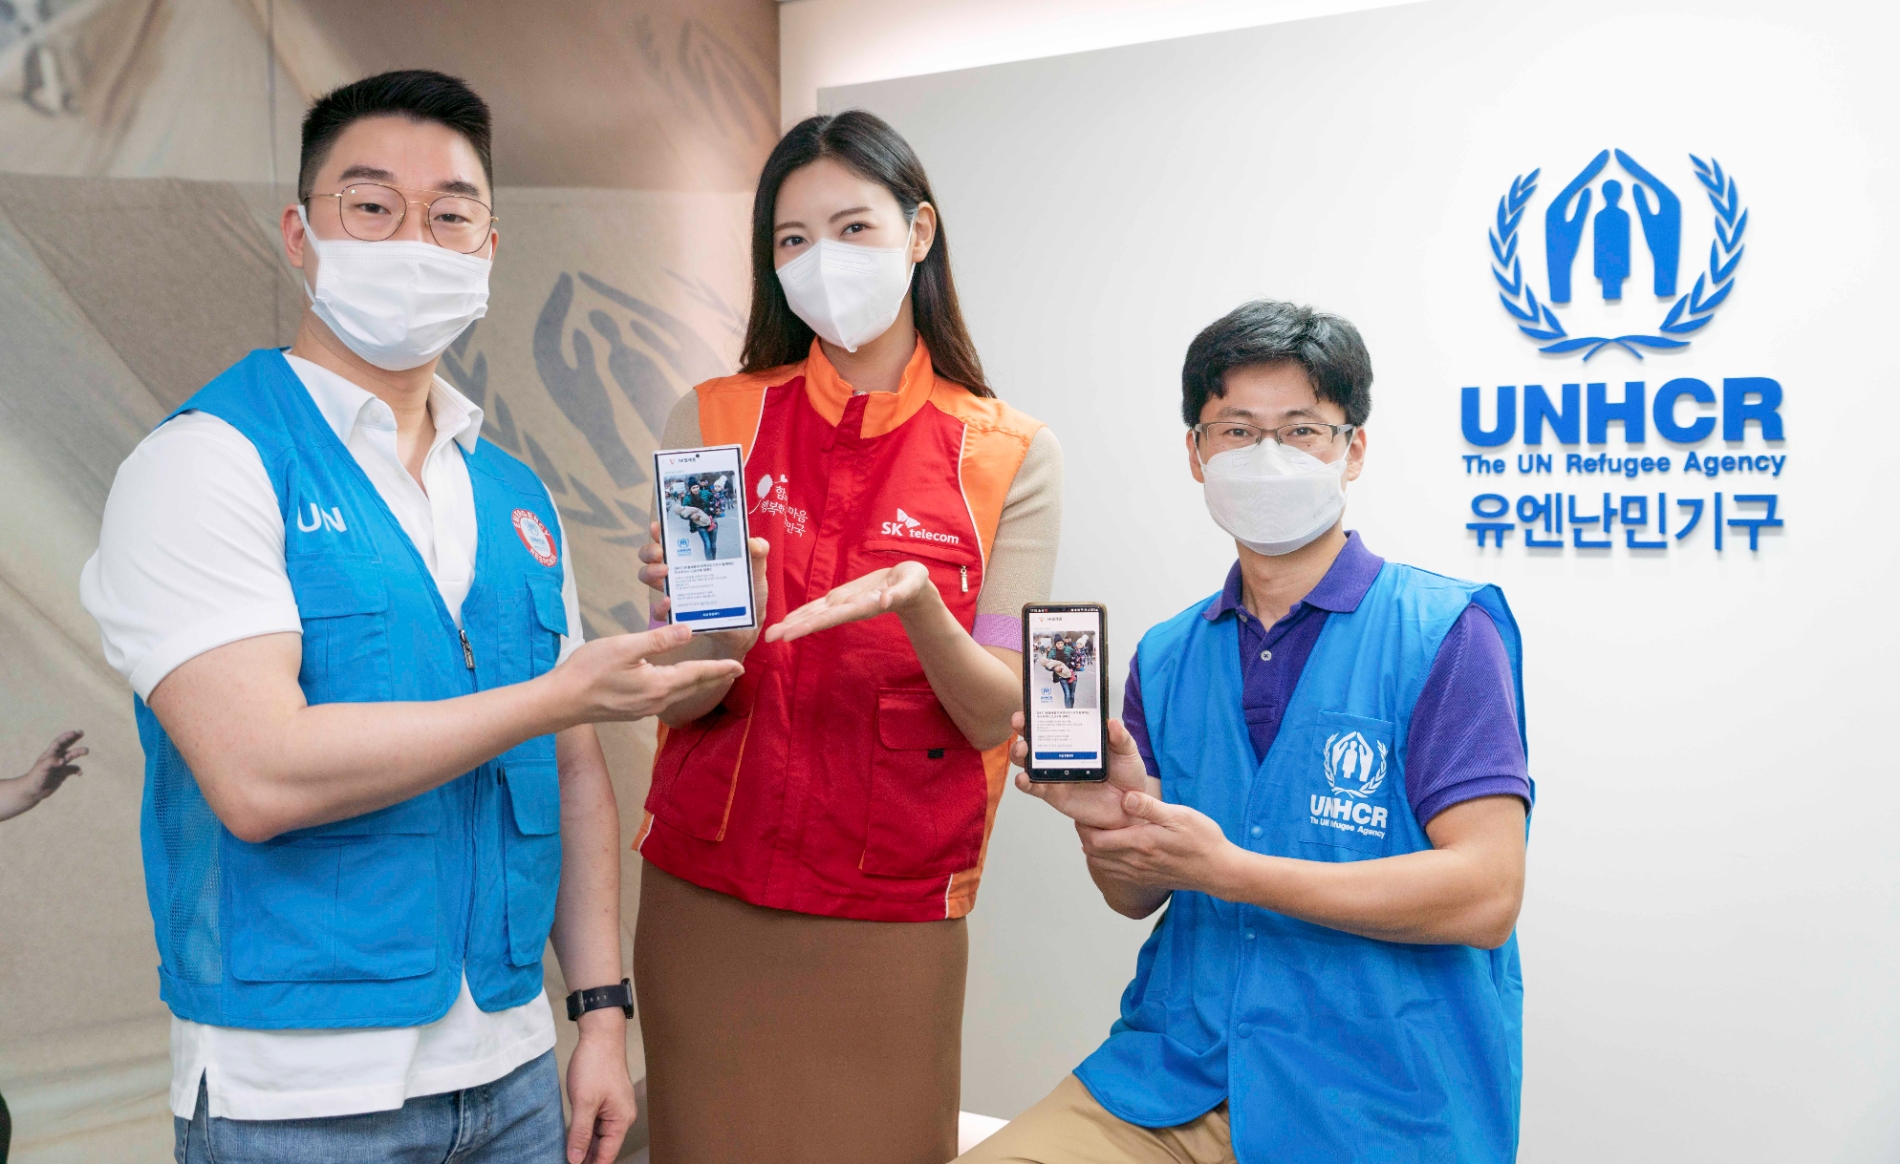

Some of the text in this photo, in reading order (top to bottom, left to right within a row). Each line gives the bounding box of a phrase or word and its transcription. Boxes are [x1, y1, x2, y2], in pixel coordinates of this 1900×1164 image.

[1461, 377, 1785, 447] UNHCR
[1462, 451, 1787, 478] The UN Refugee Agency
[776, 485, 788, 501] 함
[297, 502, 348, 533] UN
[787, 506, 808, 523] 마음
[1466, 492, 1784, 551] 유엔난민기구
[785, 522, 806, 537] 민국
[881, 521, 960, 545] SK telecom
[1310, 794, 1388, 828] UNHCR
[1357, 826, 1385, 839] Agency
